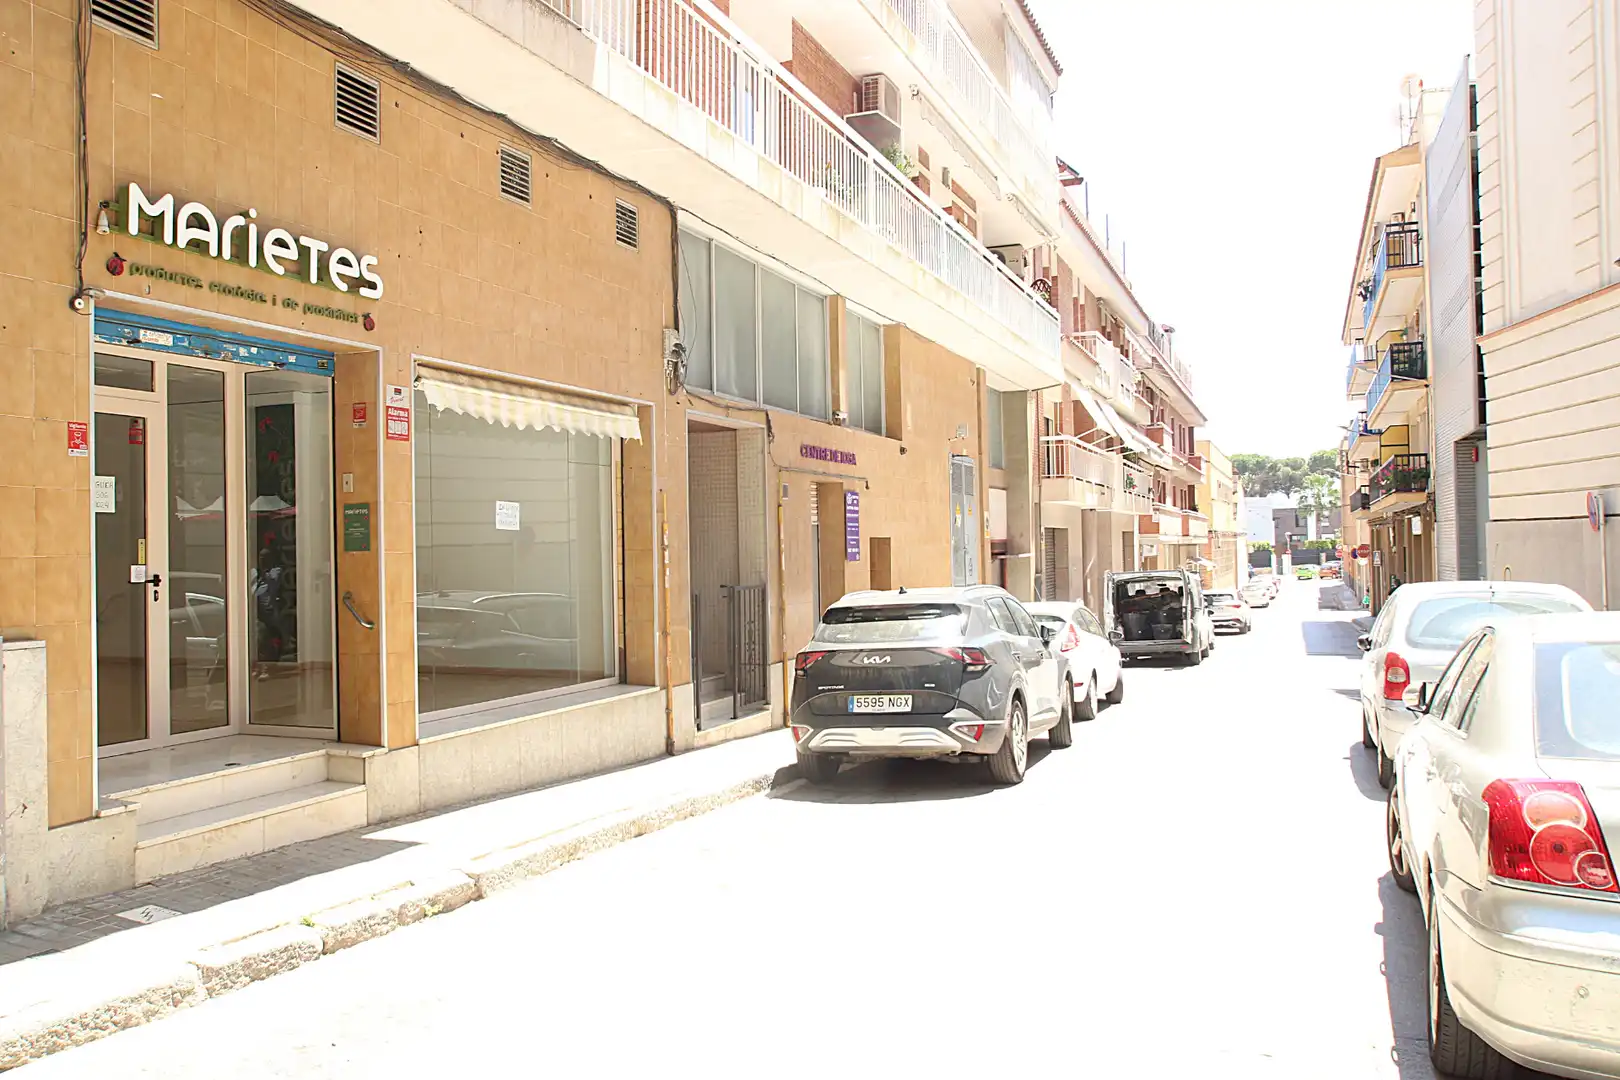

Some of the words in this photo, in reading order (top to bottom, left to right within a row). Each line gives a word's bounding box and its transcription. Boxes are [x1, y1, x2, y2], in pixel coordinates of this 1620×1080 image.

[388, 407, 408, 418] Alarma
[856, 697, 884, 708] 5595
[888, 697, 910, 708] NGX
